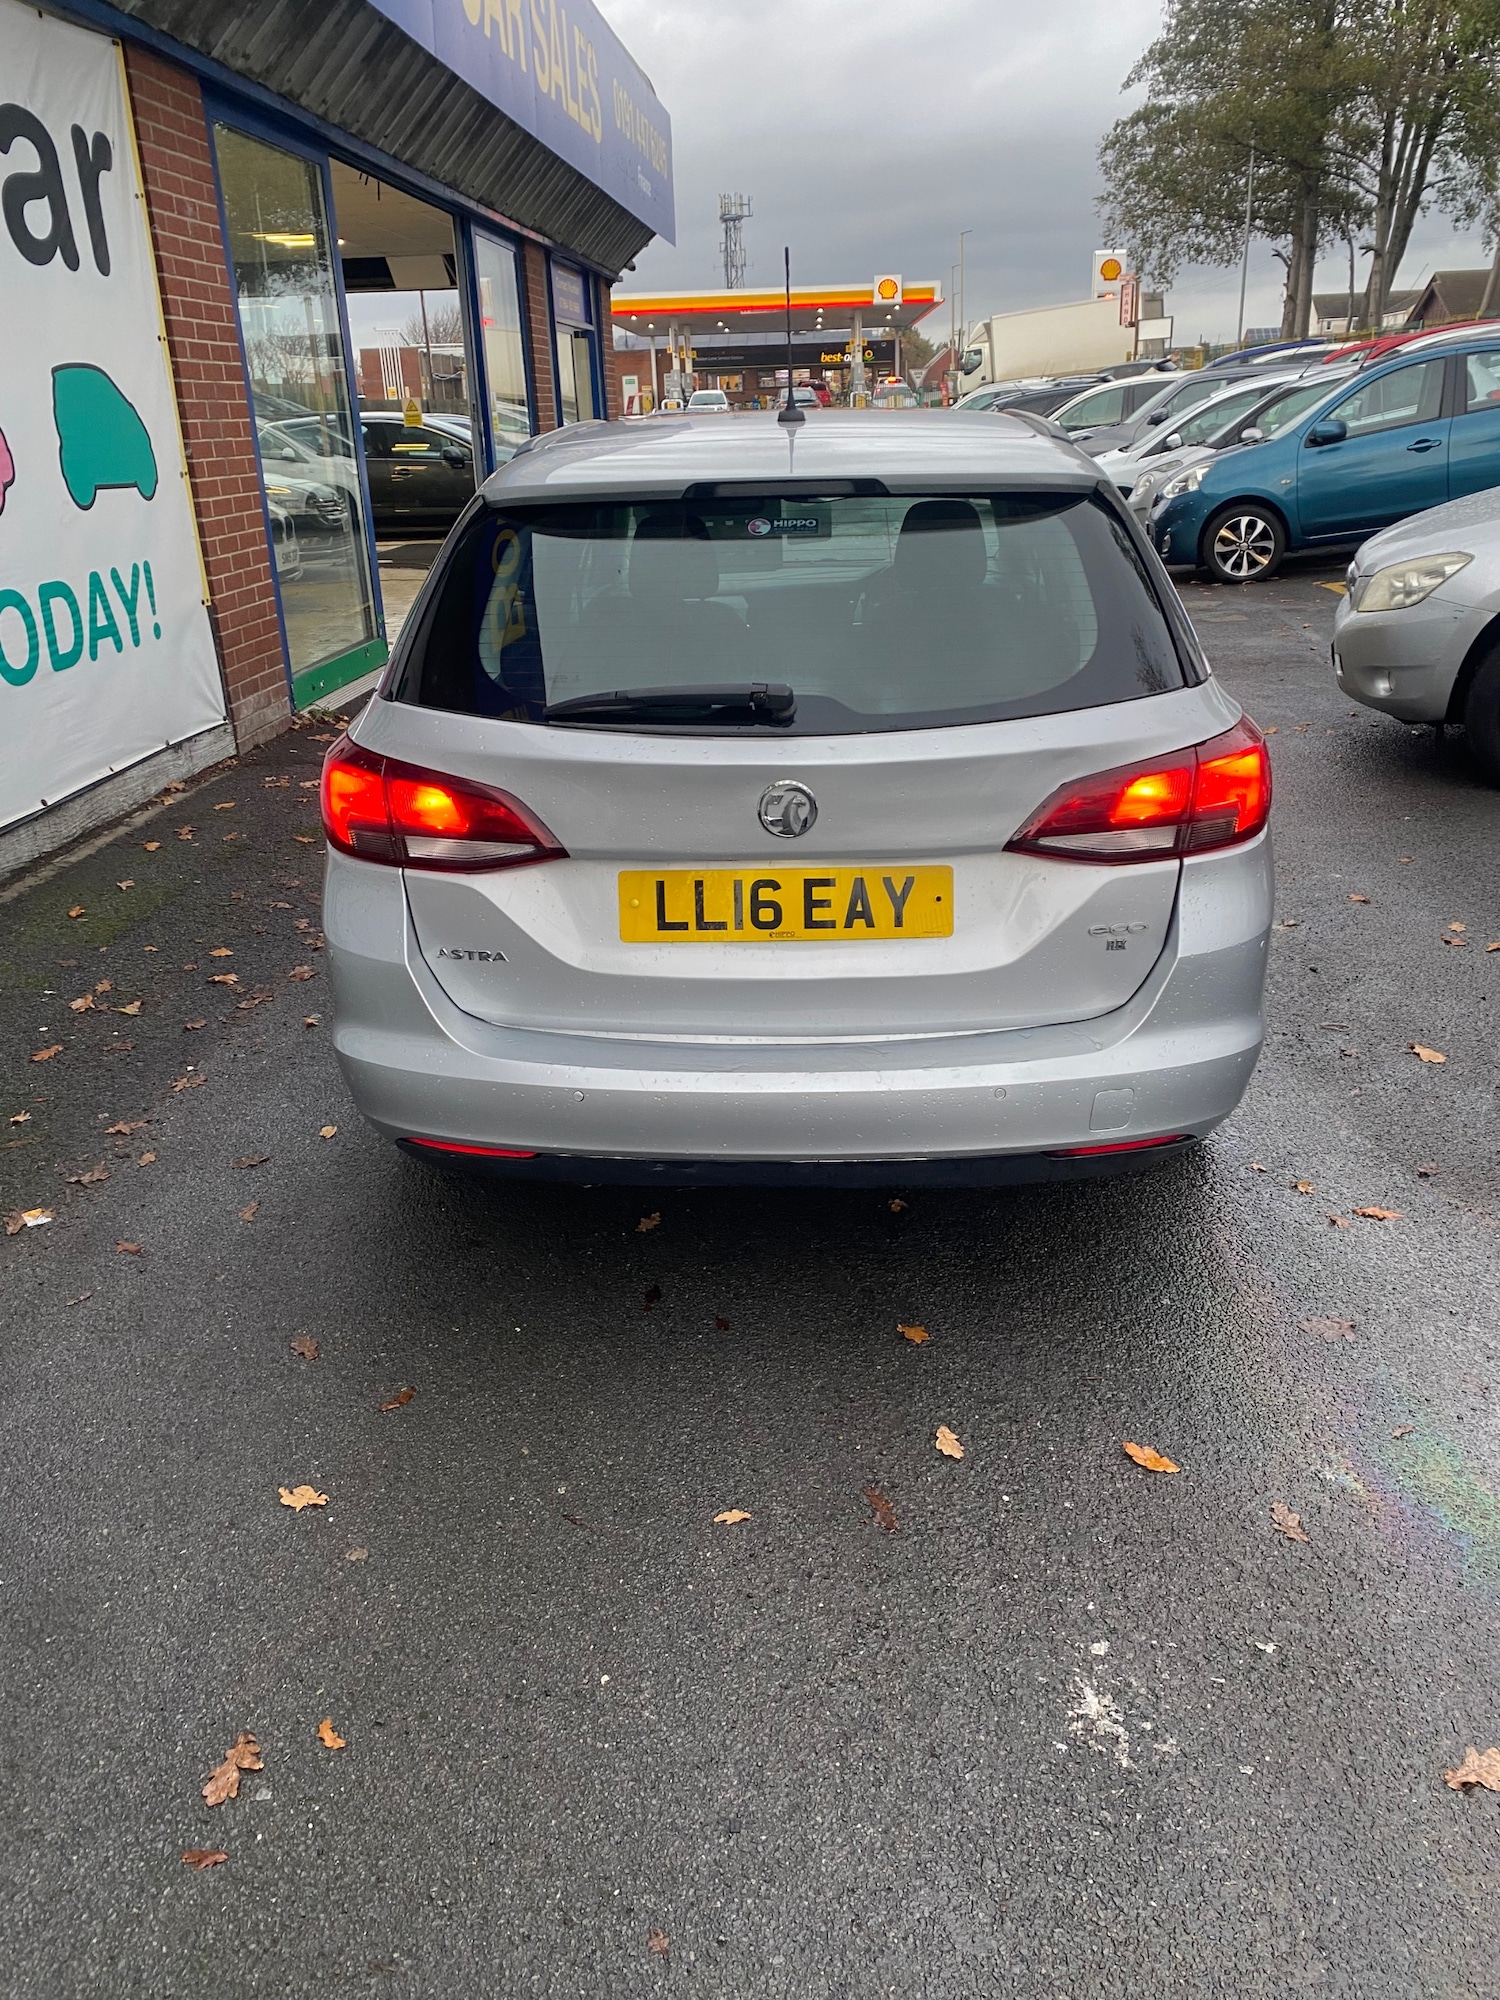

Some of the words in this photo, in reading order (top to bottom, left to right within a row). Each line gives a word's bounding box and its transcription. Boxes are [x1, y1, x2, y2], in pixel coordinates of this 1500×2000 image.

[530, 0, 602, 144] SALES
[613, 77, 635, 145] 0191
[820, 351, 853, 363] best-o
[773, 519, 817, 528] HIPPO
[655, 878, 783, 931] LL16
[803, 875, 915, 930] EAY
[436, 947, 510, 962] ASTRA
